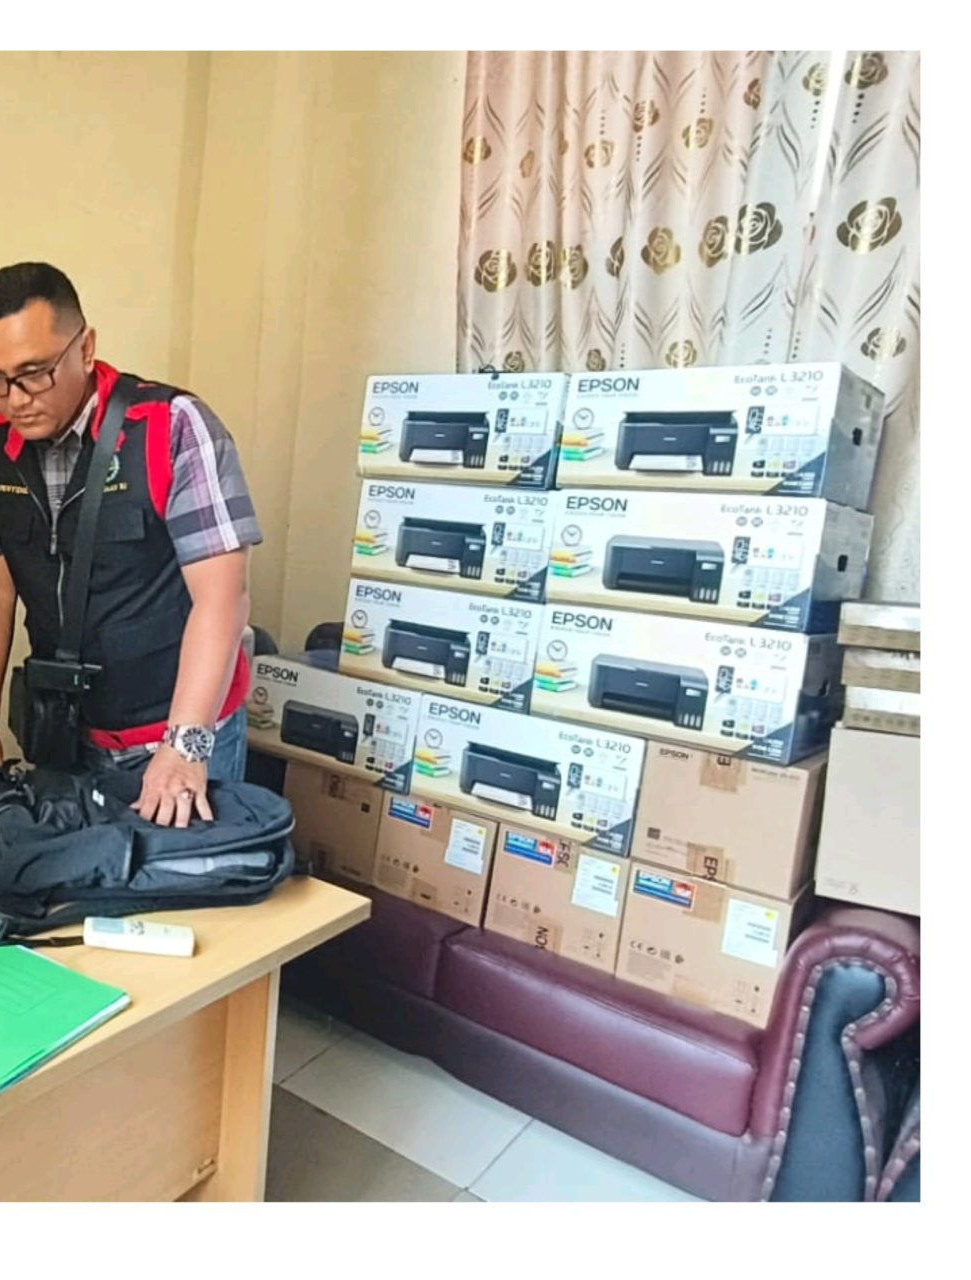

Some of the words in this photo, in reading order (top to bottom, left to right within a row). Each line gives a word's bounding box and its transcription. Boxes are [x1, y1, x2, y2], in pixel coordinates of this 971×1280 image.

[521, 379, 553, 390] L3210
[578, 377, 640, 393] EPSON
[734, 373, 777, 385] EcoTank
[780, 370, 824, 383] L3210
[372, 381, 420, 394] EPSON
[368, 485, 416, 500] EPSON
[517, 495, 549, 507] L3210
[566, 495, 629, 512] EPSON
[766, 504, 809, 517] L3210
[355, 585, 402, 603] EPSON
[501, 604, 532, 619] L3210
[551, 610, 613, 632] EPSON
[750, 635, 792, 651] L3210
[256, 663, 299, 683] EPSON
[428, 701, 481, 725] EPSON
[595, 737, 631, 755] L3210
[659, 747, 690, 761] EPSON
